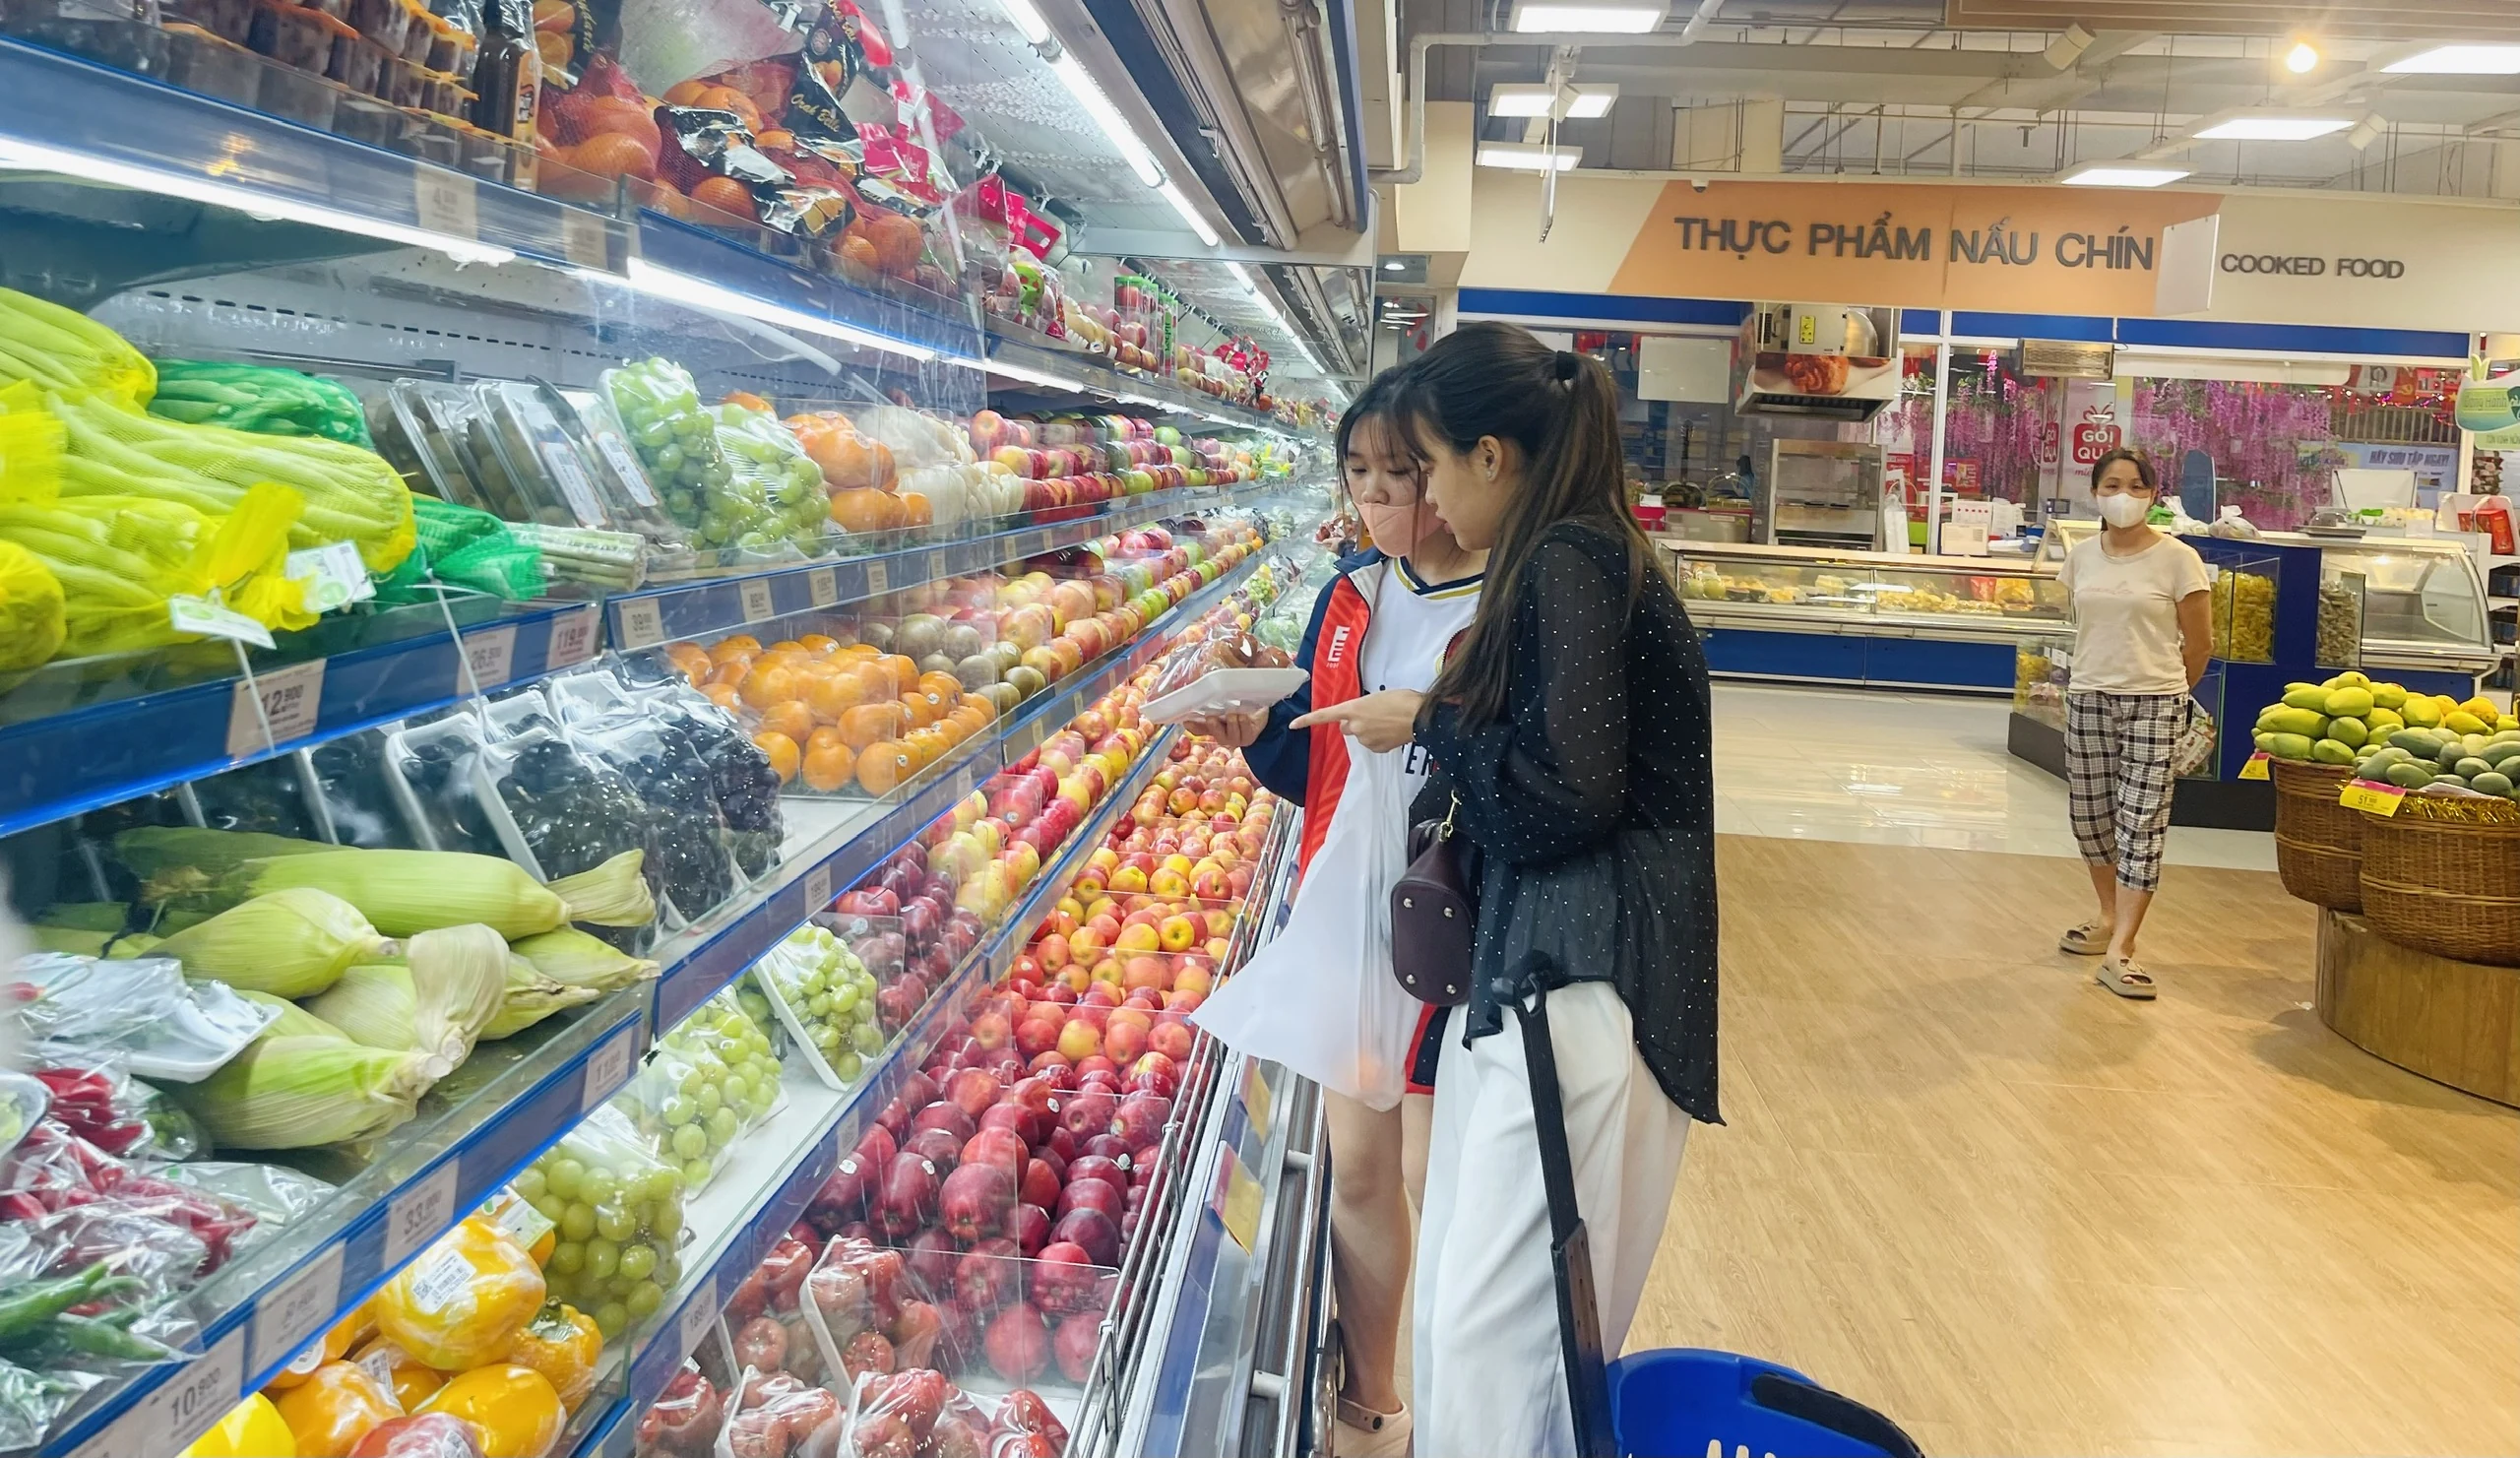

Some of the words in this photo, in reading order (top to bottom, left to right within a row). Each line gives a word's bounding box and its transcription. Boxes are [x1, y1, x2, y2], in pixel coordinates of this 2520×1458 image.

[1673, 217, 1792, 260] THỰC
[1808, 210, 1931, 261] PHẨM
[1949, 216, 2039, 265] NẤU
[2054, 224, 2154, 270] CHÍN
[2220, 253, 2326, 276] COOKED
[2336, 258, 2405, 279] FOOD
